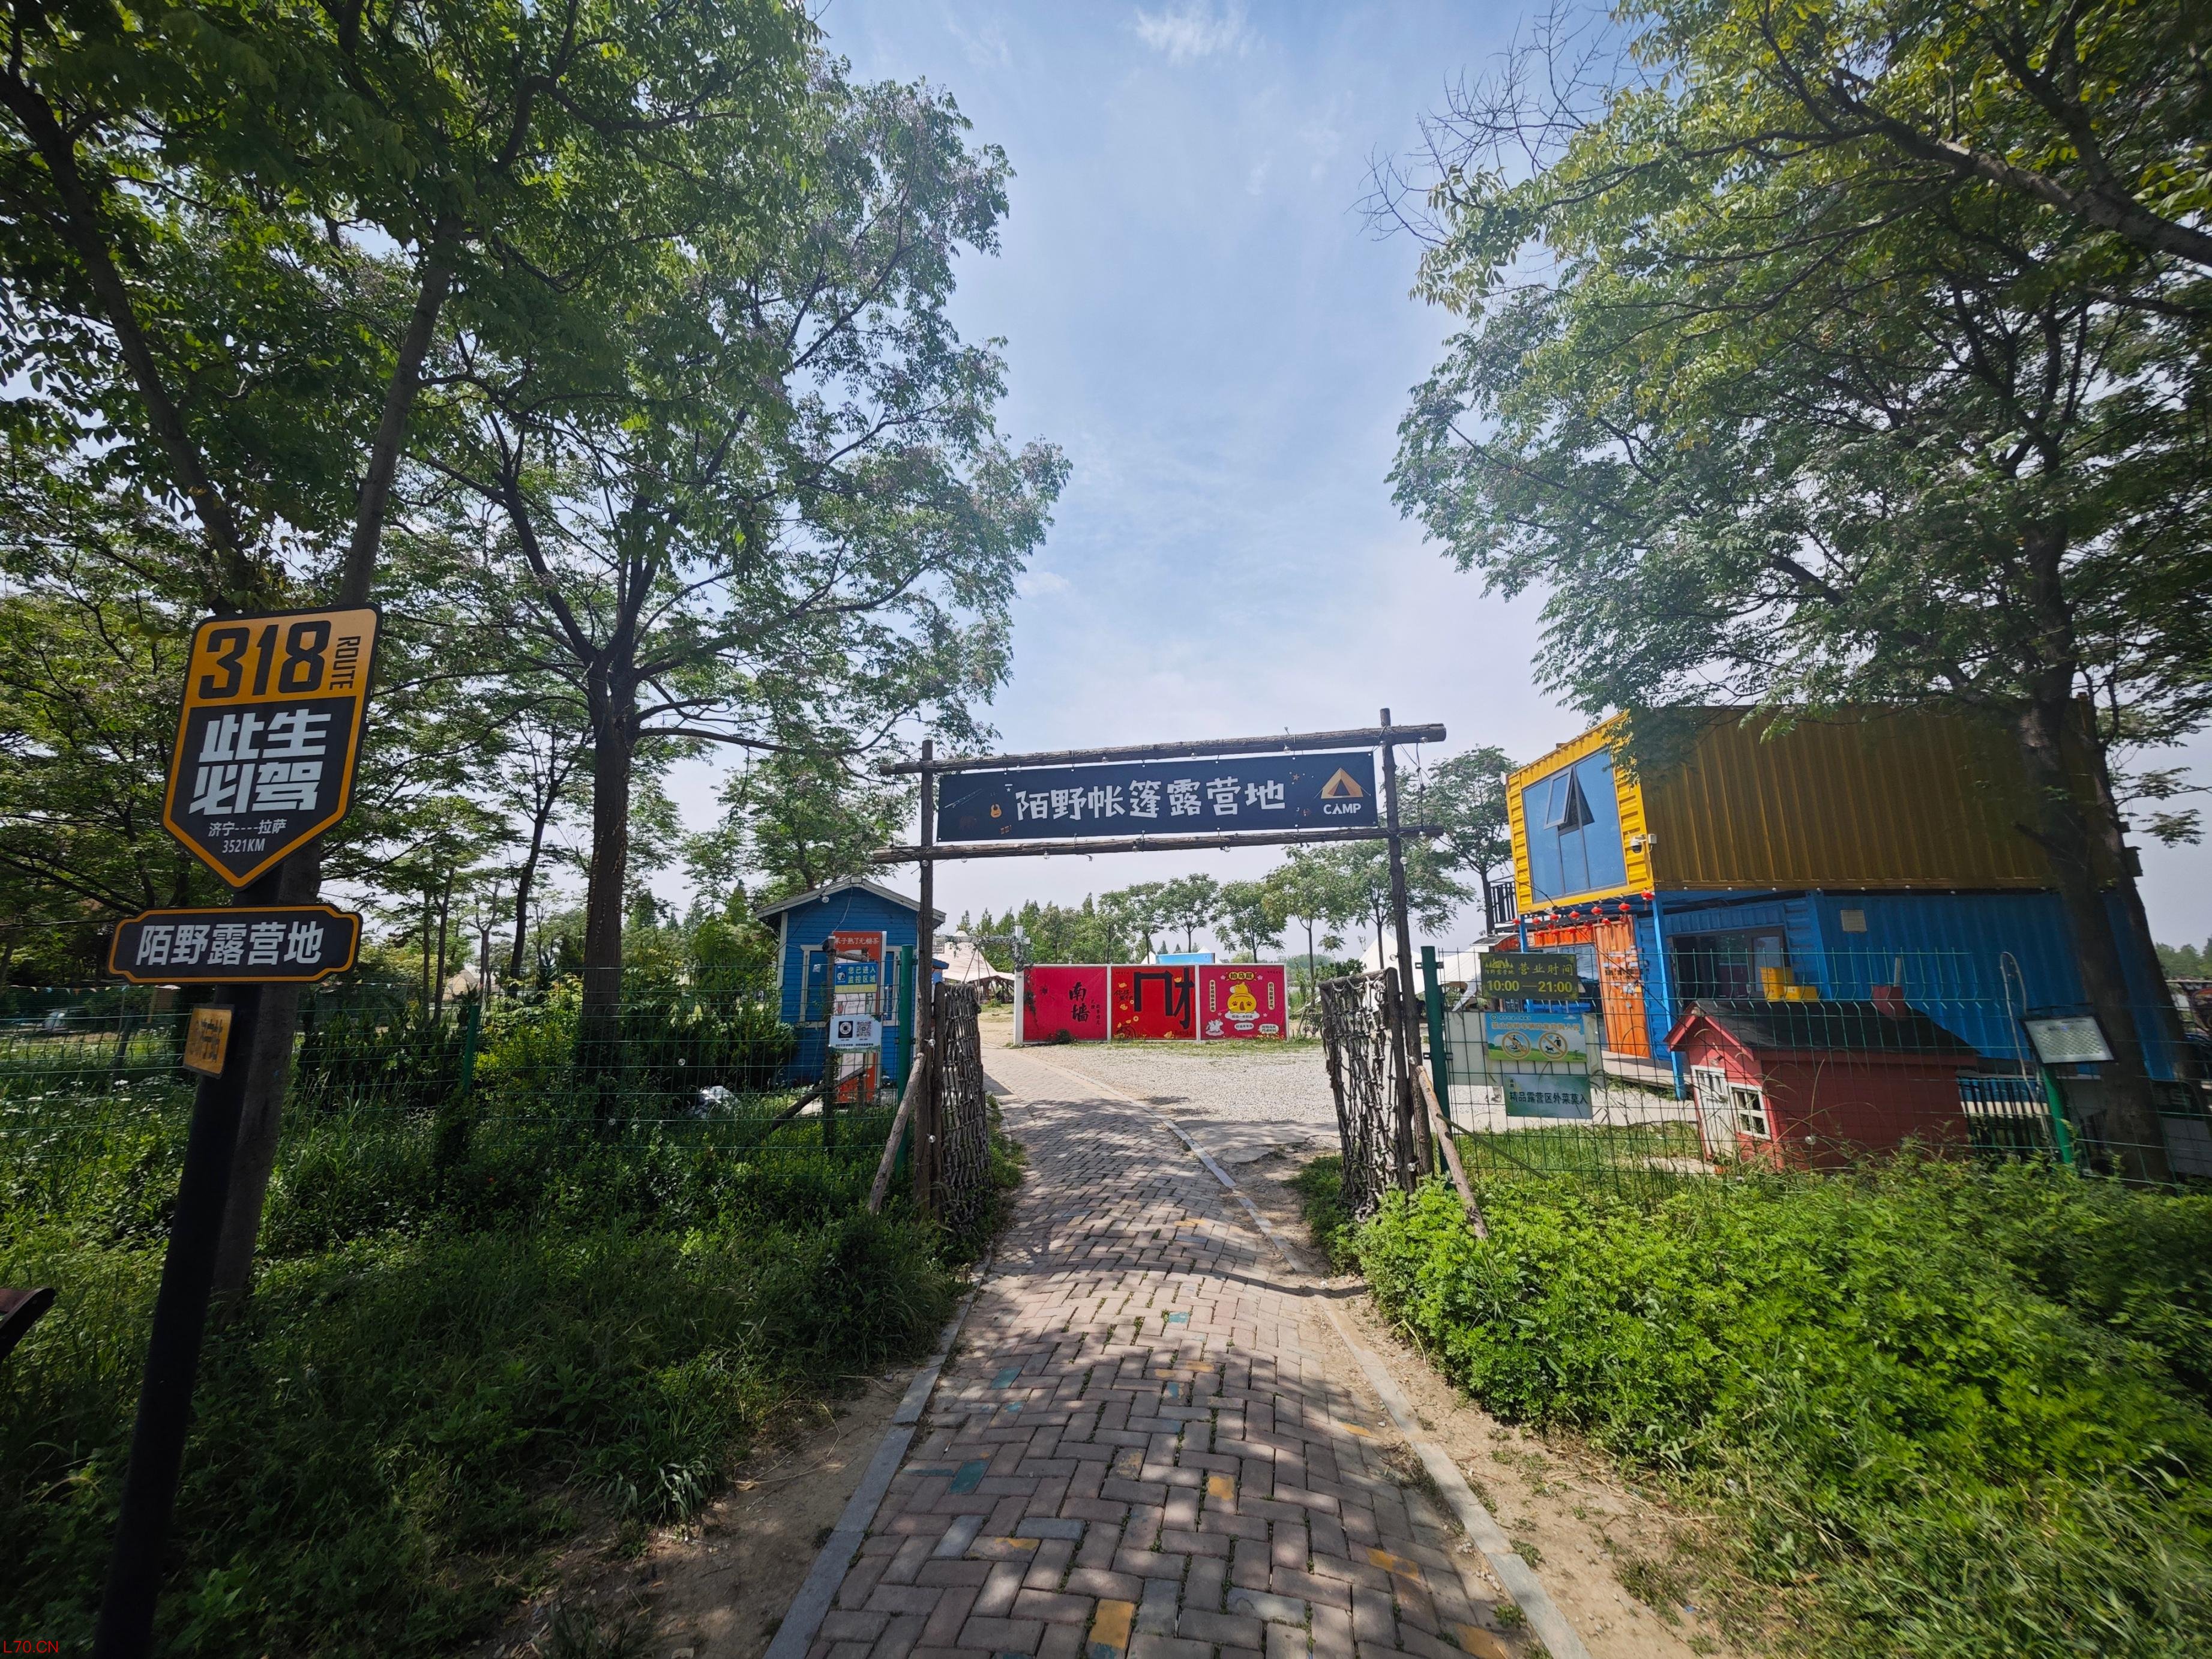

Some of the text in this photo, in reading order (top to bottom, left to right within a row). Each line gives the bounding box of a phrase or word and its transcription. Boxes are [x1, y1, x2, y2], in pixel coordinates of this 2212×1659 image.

[199, 621, 331, 699] 318
[329, 636, 361, 691] ROUTE
[199, 708, 331, 762] 此生
[189, 761, 323, 815] 必驾
[1016, 776, 1285, 822] 陌野帐篷露营地
[1323, 802, 1362, 815] CAMP
[221, 838, 265, 854] 3521KM
[136, 921, 324, 966] 陌野露营地
[848, 975, 876, 983] 监控区域
[1518, 962, 1573, 976] 营业时间
[1069, 981, 1090, 1023] 南墙
[1509, 1091, 1588, 1104] 精品露营区外菜莫入
